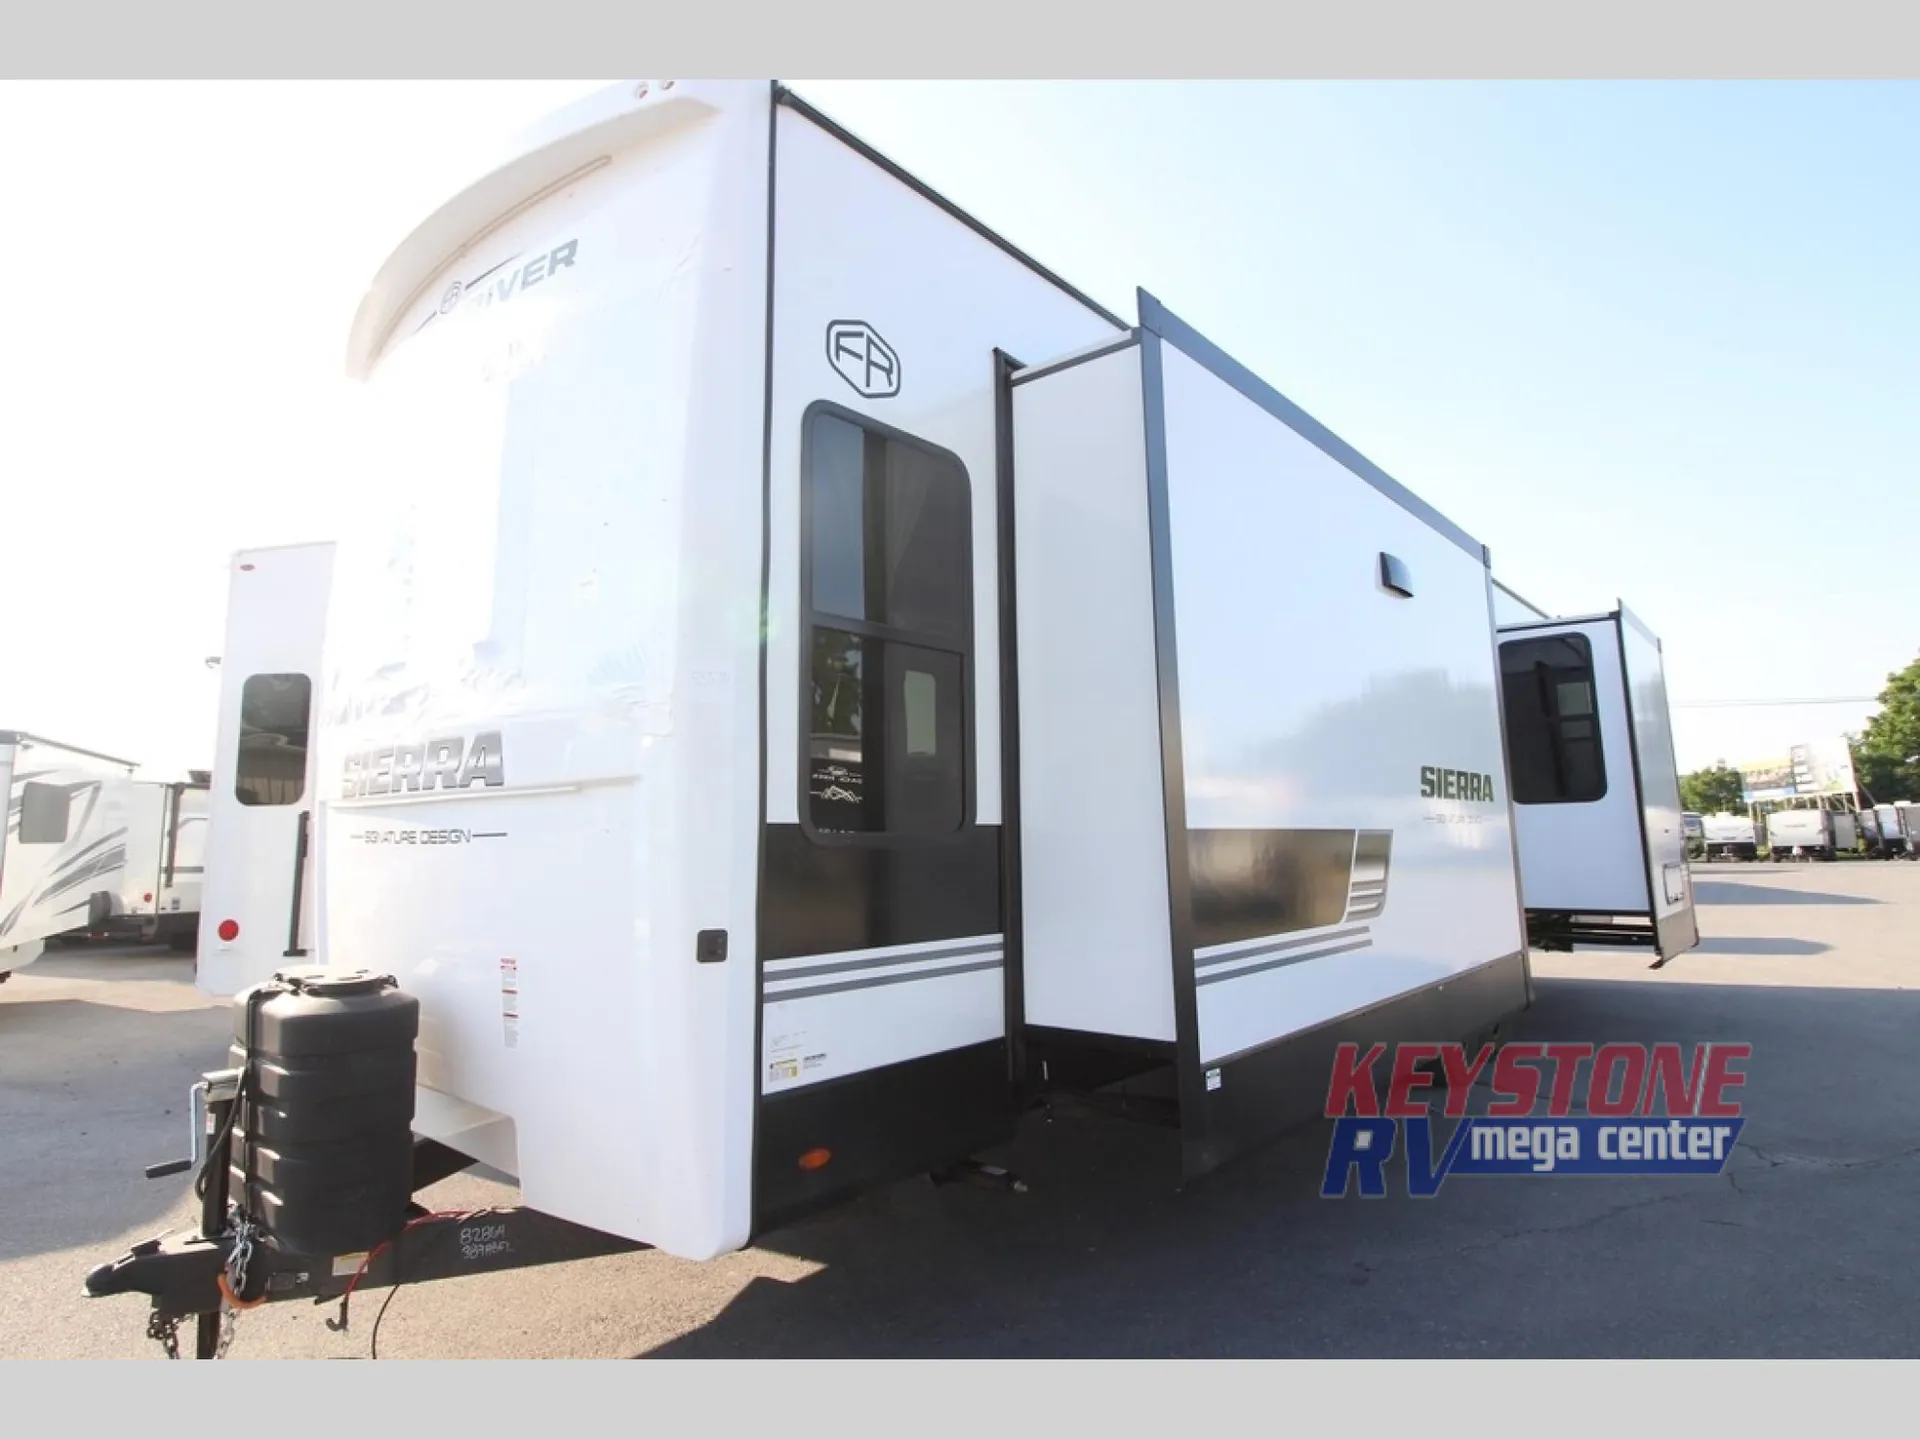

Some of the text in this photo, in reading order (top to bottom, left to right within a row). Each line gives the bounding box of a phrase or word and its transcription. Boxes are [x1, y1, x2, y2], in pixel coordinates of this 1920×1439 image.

[342, 730, 504, 799] SIERRA
[1421, 766, 1494, 802] SIERRA
[420, 829, 472, 845] DESIGN
